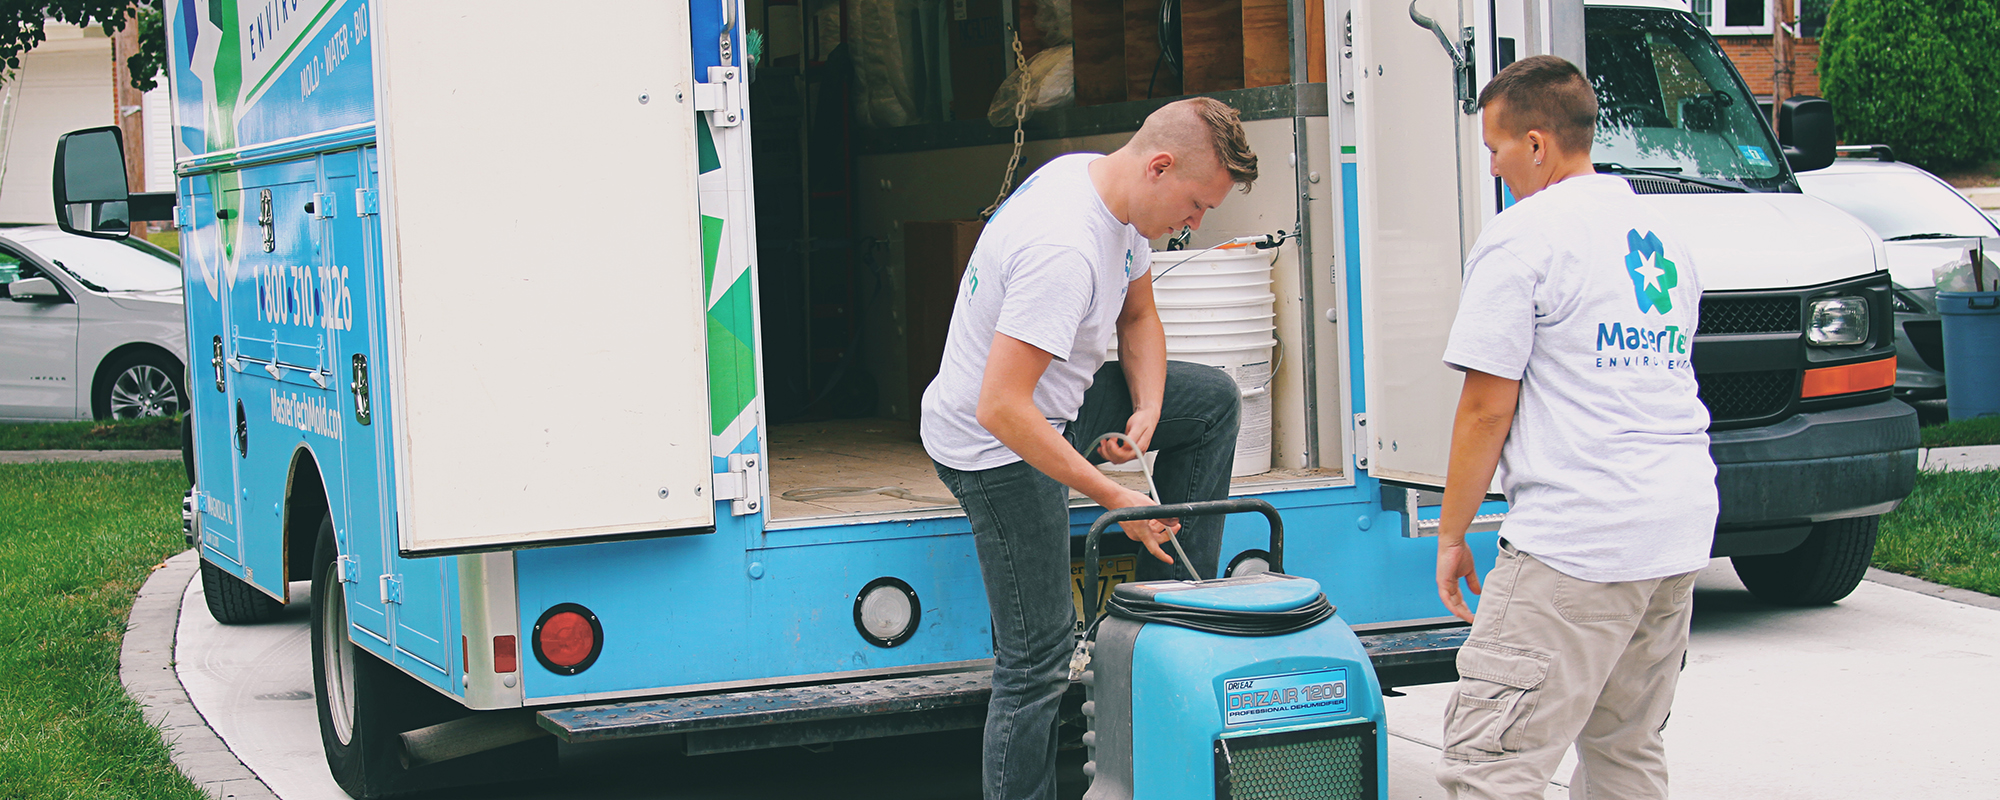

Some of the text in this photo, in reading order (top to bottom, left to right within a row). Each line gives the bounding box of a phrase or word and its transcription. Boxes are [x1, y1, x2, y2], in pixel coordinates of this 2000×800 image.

[300, 3, 368, 103] MOLD WATER BIO
[1228, 682, 1345, 711] DRIZAIR 1200
[1229, 699, 1345, 717] PROFESSIONAL DEHUMIDIFIER
